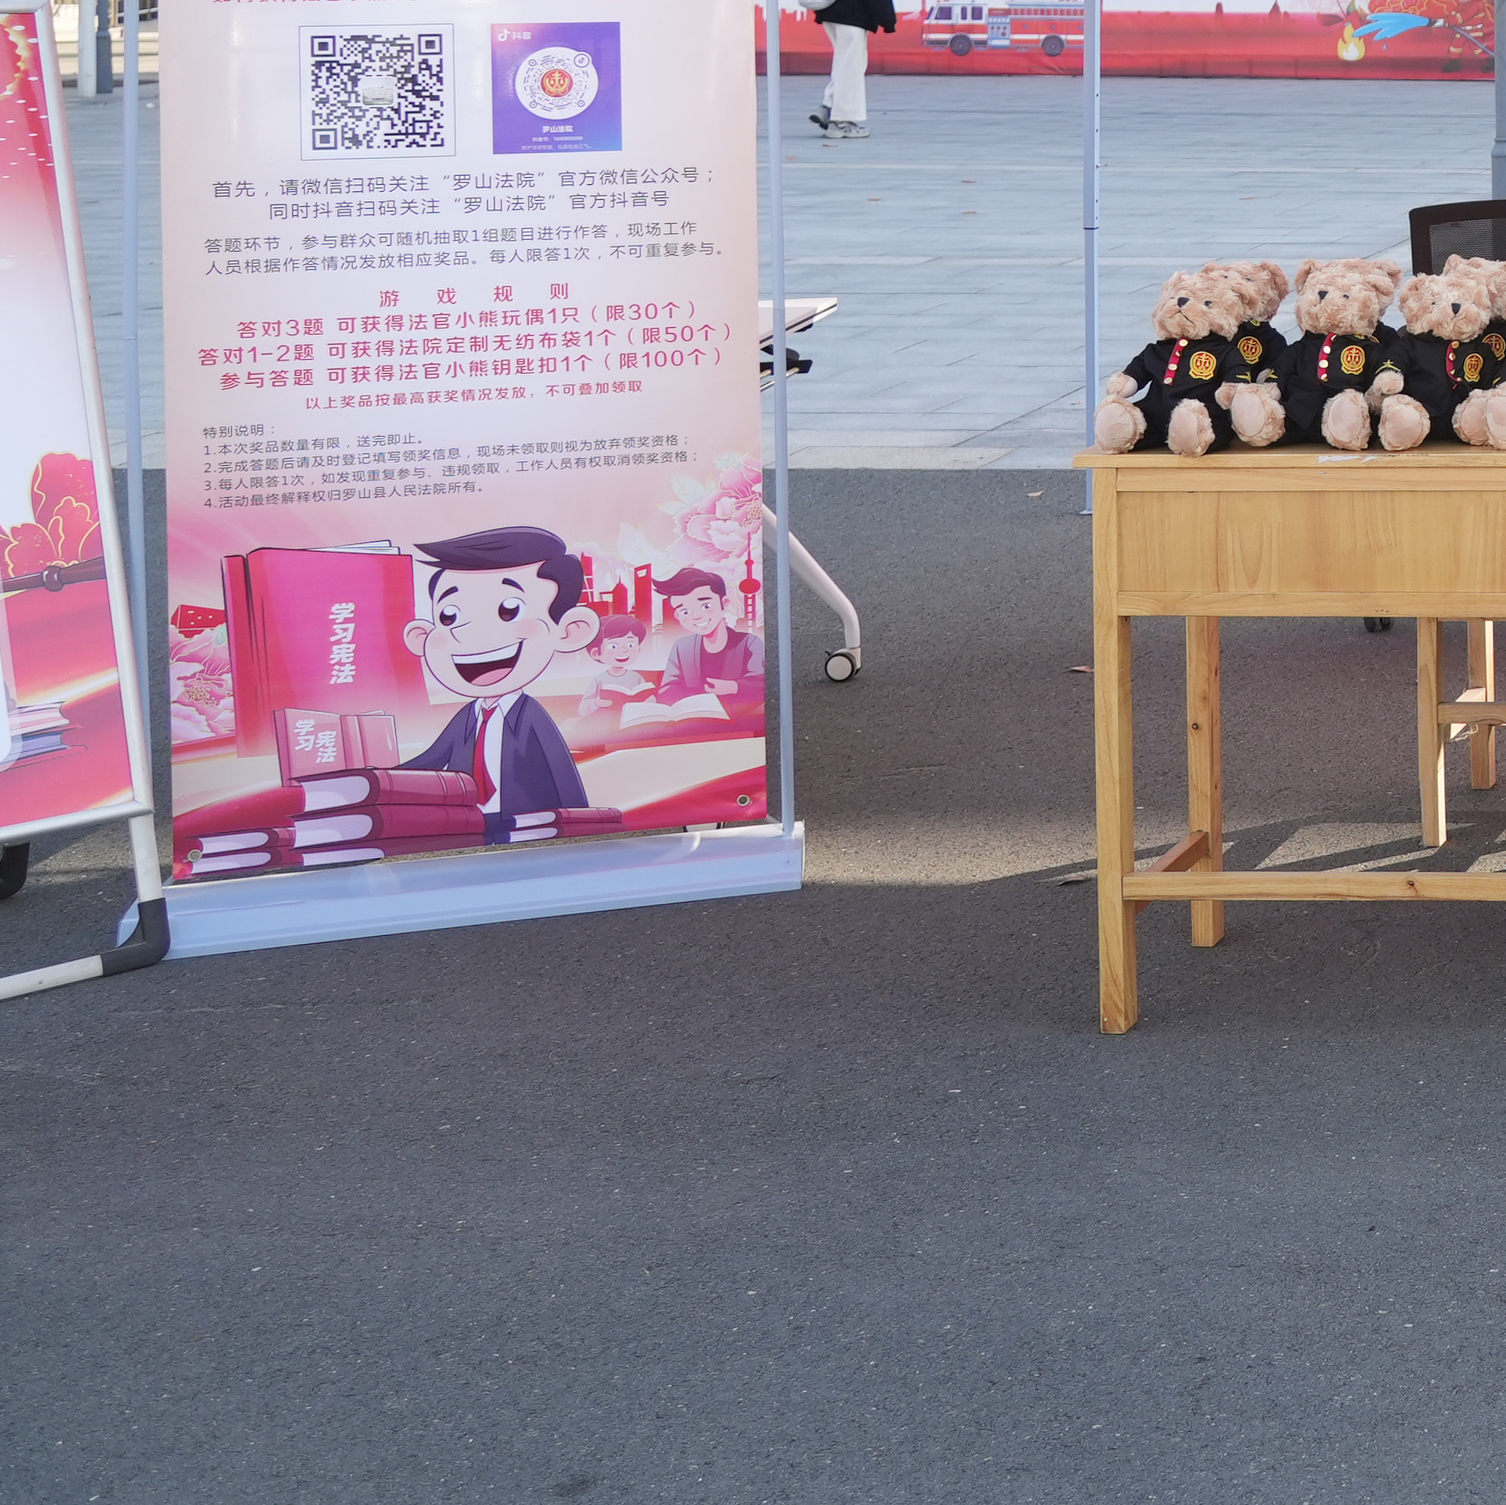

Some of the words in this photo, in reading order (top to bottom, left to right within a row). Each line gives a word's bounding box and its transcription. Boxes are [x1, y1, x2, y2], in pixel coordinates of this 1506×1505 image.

[269, 189, 670, 221] 同时抖音扫码关注“罗山法院”官方抖音号
[204, 220, 698, 255] 答题环节，参与群众可随机抽取1组题目进行作答，现场工作
[205, 241, 724, 276] 人员根据作答情况发放相应奖品。每人限答1次，不可重复参与。
[237, 318, 324, 341] 答对3题
[337, 300, 699, 335] 可获得法官小熊玩偶1只（限30个）
[198, 343, 315, 367] 答对1-2题
[327, 322, 734, 362] 可获得法院定制无纺布袋1个（限50个）
[219, 367, 315, 391] 参与答题
[327, 347, 724, 385] 可获得法官小熊钥匙扣1个（限100个）
[305, 380, 643, 411] 以上奖品按最高获奖情况发放，不可叠加领取
[202, 423, 276, 439] 特别说明：
[203, 432, 423, 457] 1.本次奖品数量有限，送完即止。
[203, 481, 486, 509] 4.活动最终解释权归罗山县人民法院所有。
[329, 601, 356, 686] 学习宪法
[294, 718, 316, 752] 学习
[315, 730, 338, 764] 宪法
